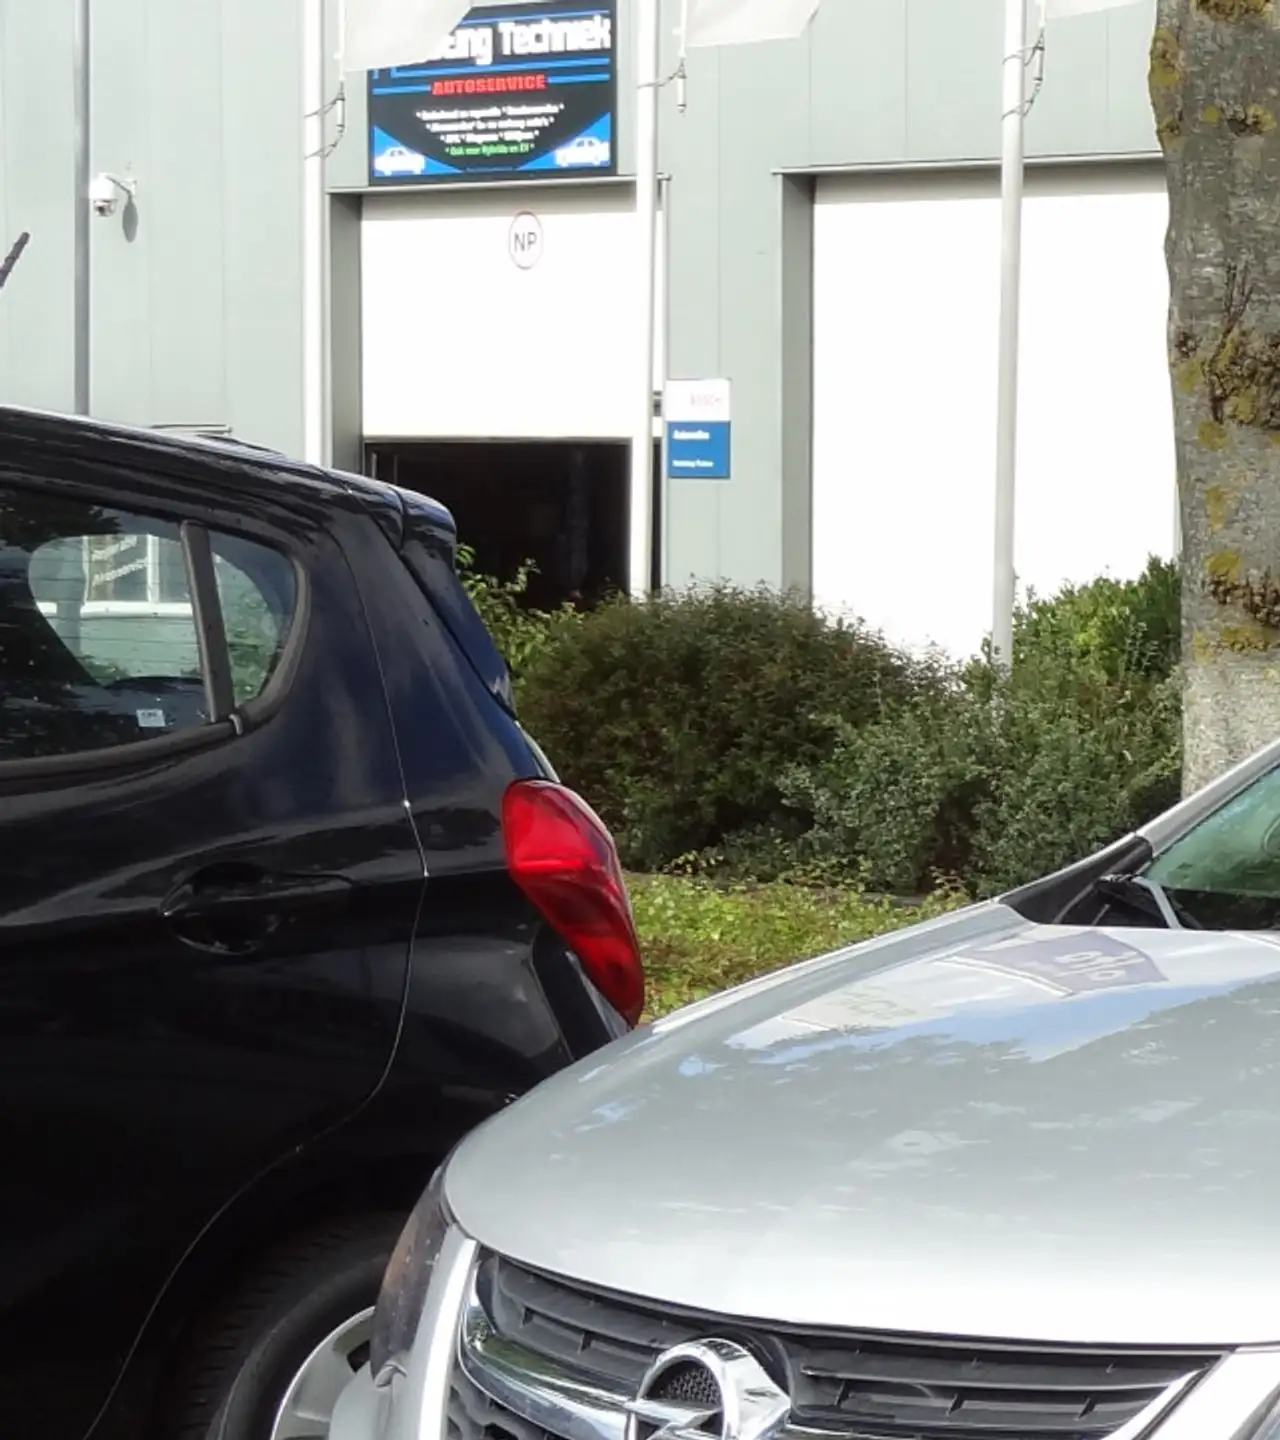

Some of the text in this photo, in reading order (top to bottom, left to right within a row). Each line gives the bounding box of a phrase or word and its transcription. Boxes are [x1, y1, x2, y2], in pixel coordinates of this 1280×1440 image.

[498, 15, 612, 55] Techniek
[432, 74, 546, 97] AUTOSERVICE
[514, 231, 538, 253] NP
